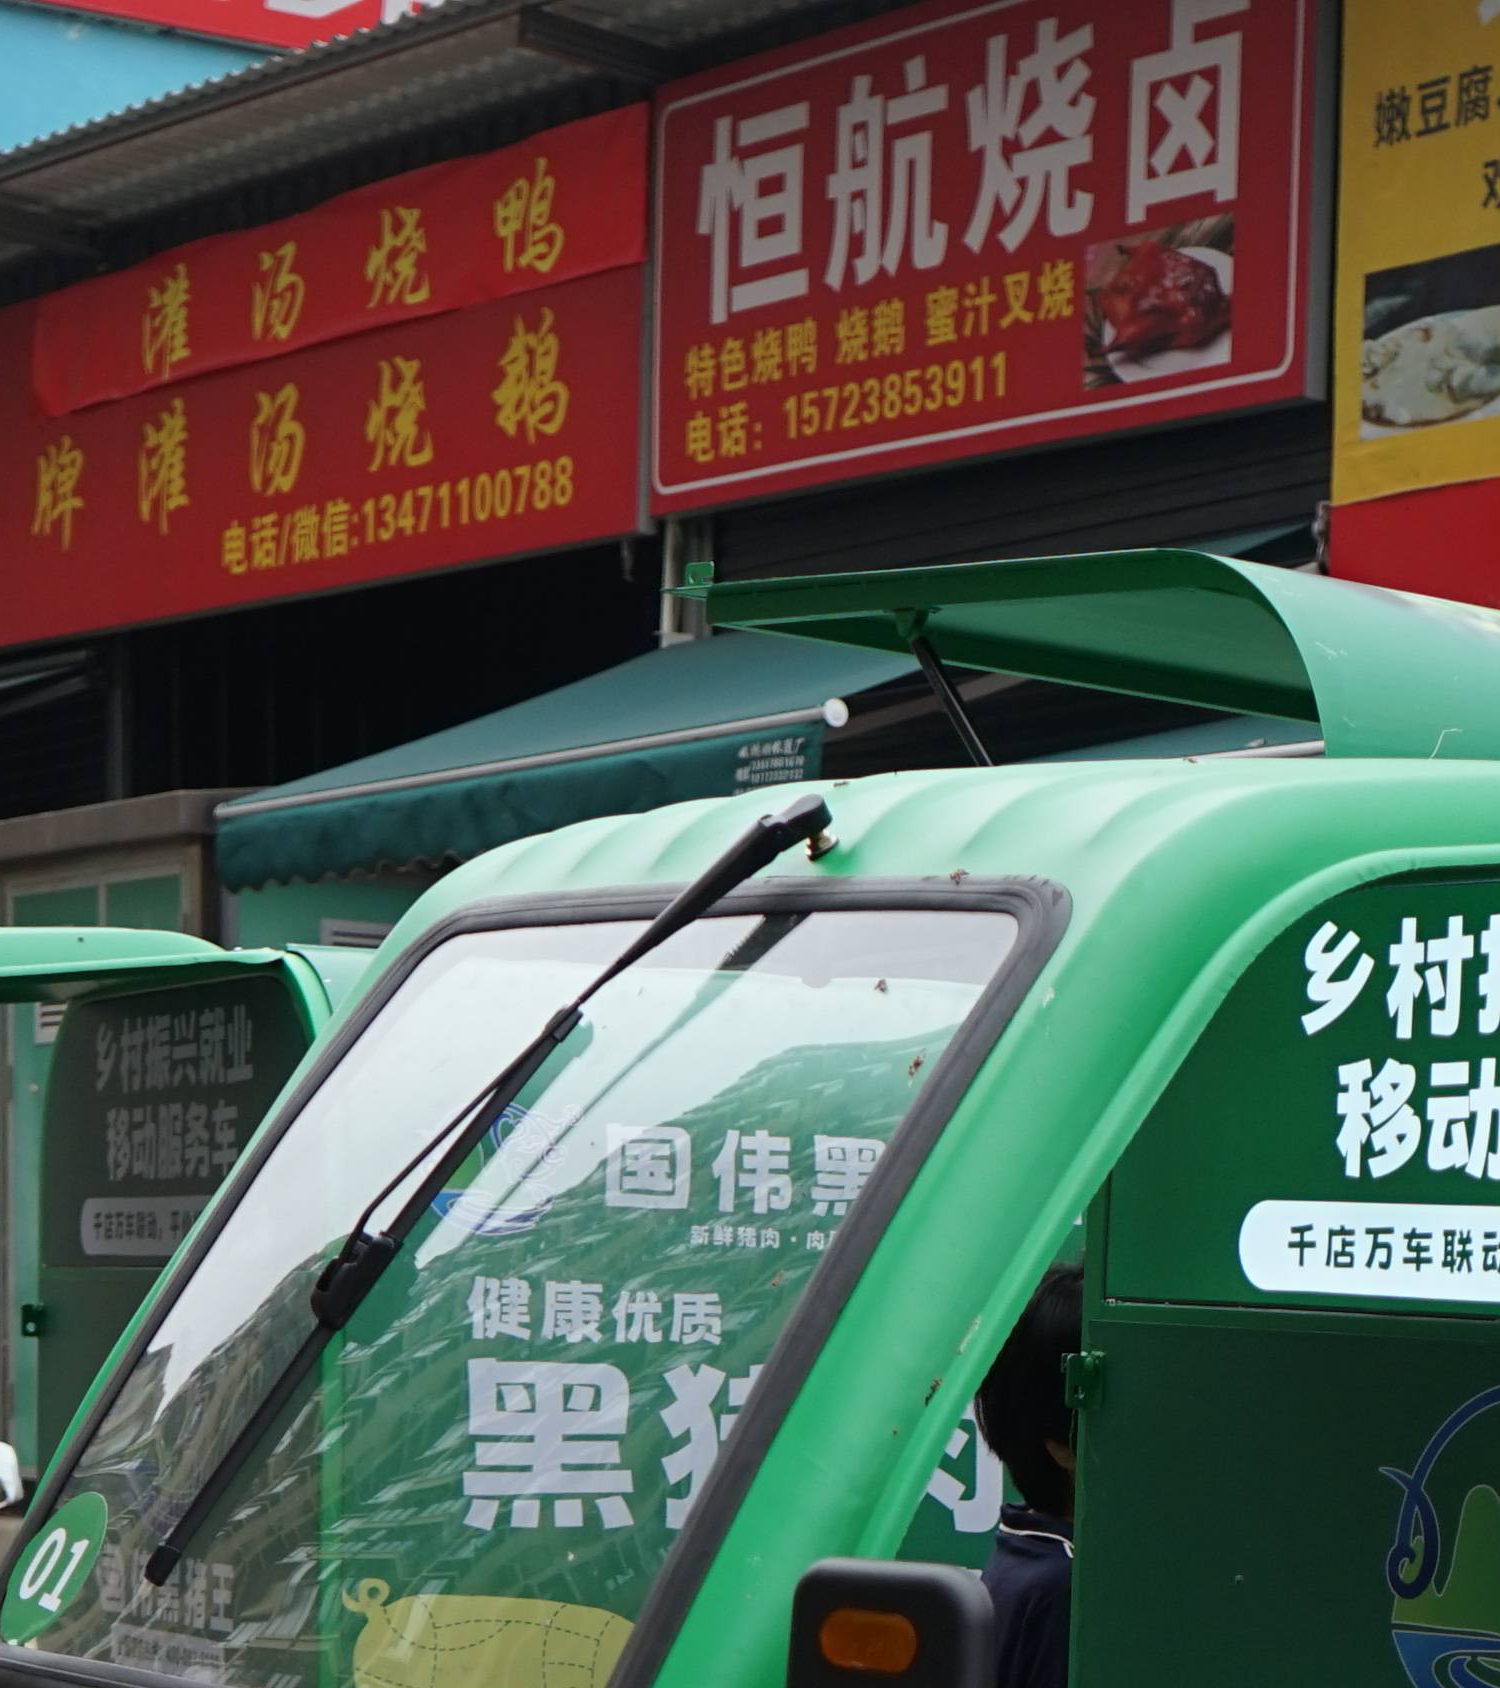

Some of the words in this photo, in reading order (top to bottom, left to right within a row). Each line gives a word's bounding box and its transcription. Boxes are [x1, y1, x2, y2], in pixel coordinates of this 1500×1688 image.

[695, 0, 1250, 325] 恒航烧卤
[142, 156, 566, 381] 灌汤烧鸭
[684, 318, 818, 400] 特色烧鸭
[835, 298, 905, 368] 烧鹅
[923, 259, 1075, 351] 蜜汁叉烧
[221, 456, 574, 575] 电话/微信:13471100788
[96, 1004, 253, 1094] 乡村振兴就业
[467, 1275, 725, 1348] 健康优质
[18, 1525, 88, 1611] 01
